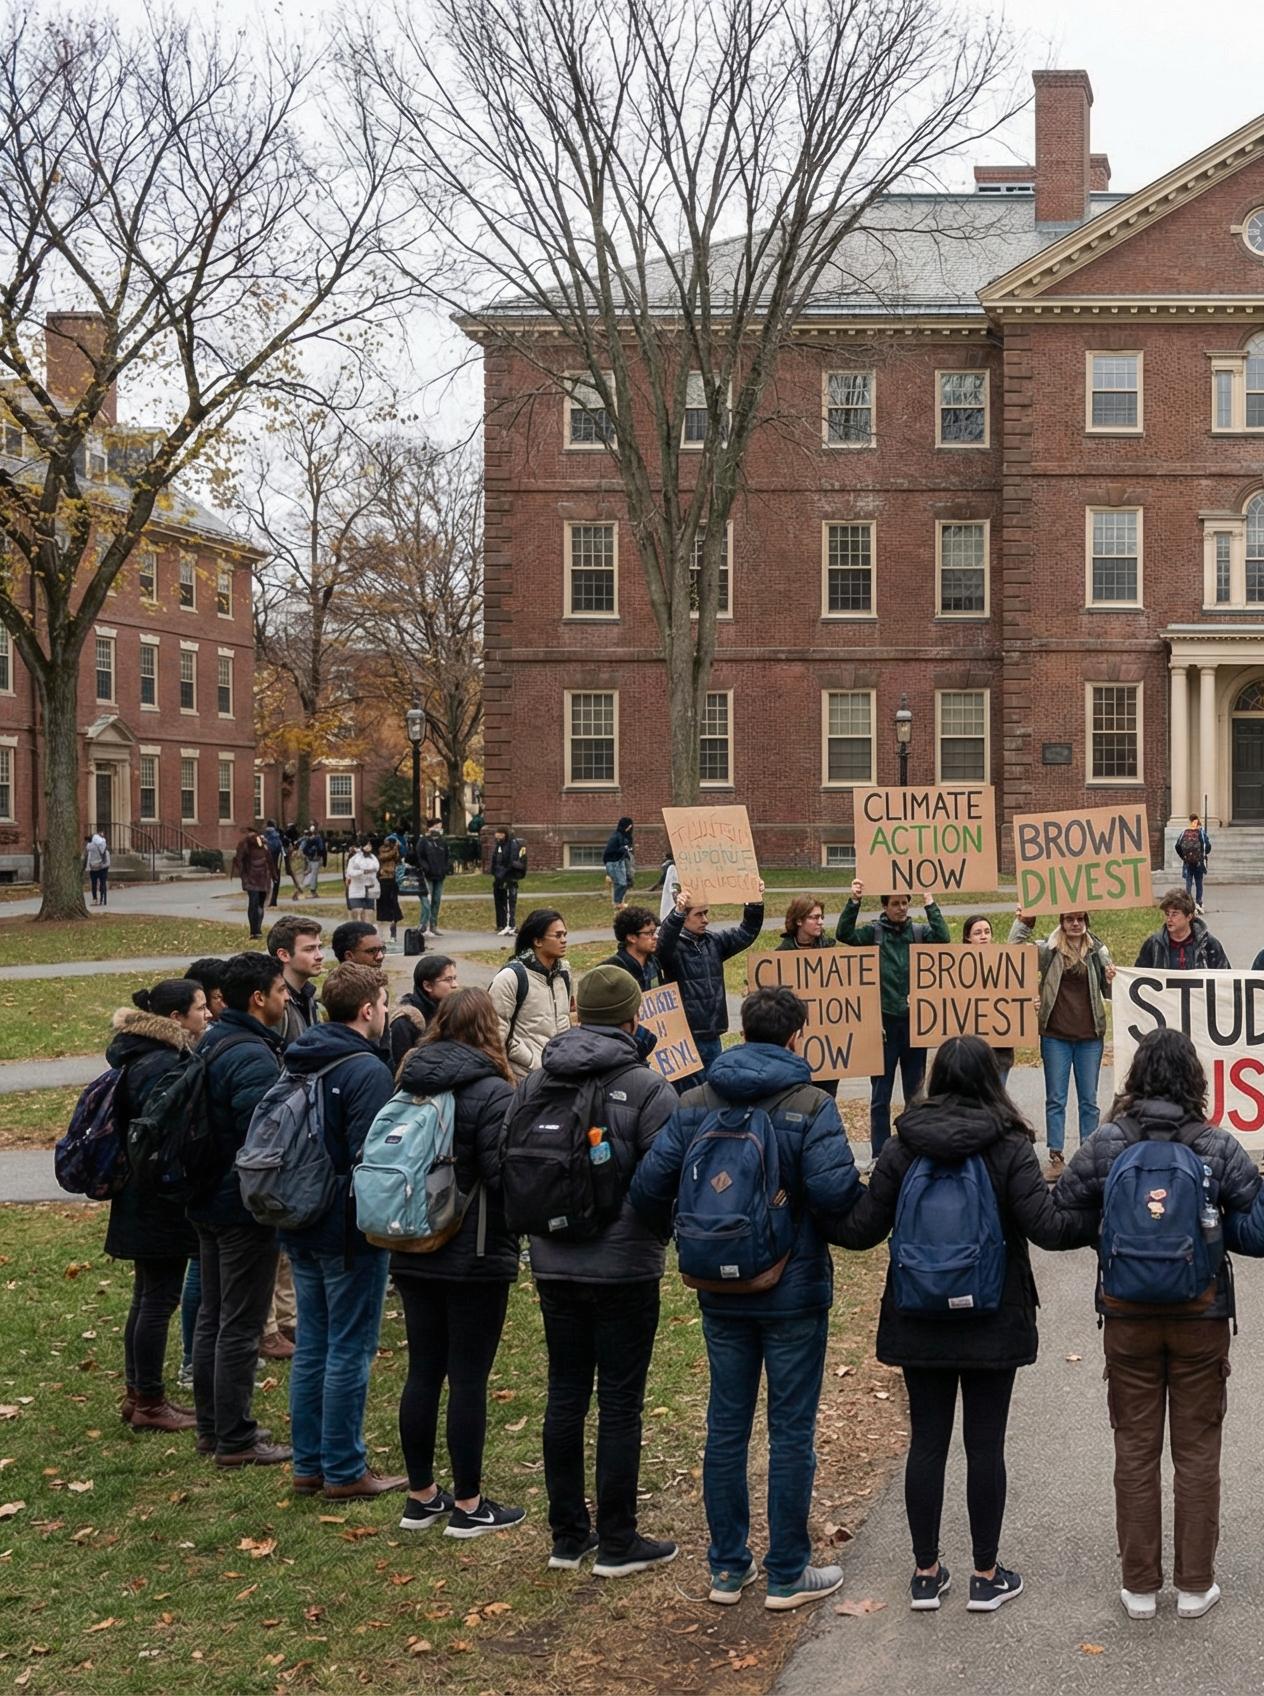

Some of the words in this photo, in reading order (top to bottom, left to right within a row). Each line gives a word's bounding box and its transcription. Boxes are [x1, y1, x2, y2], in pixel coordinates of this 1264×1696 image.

[864, 791, 983, 822] CLIMATE
[869, 824, 982, 855] ACTION
[1019, 814, 1142, 861] BROWN
[892, 858, 966, 890] NOW
[1021, 858, 1147, 908] DIVEST
[755, 954, 876, 989] CLIMATE
[917, 952, 1025, 989] BROWN
[799, 996, 862, 1026] TION
[917, 998, 1032, 1036] DIVEST
[804, 1033, 853, 1072] OW
